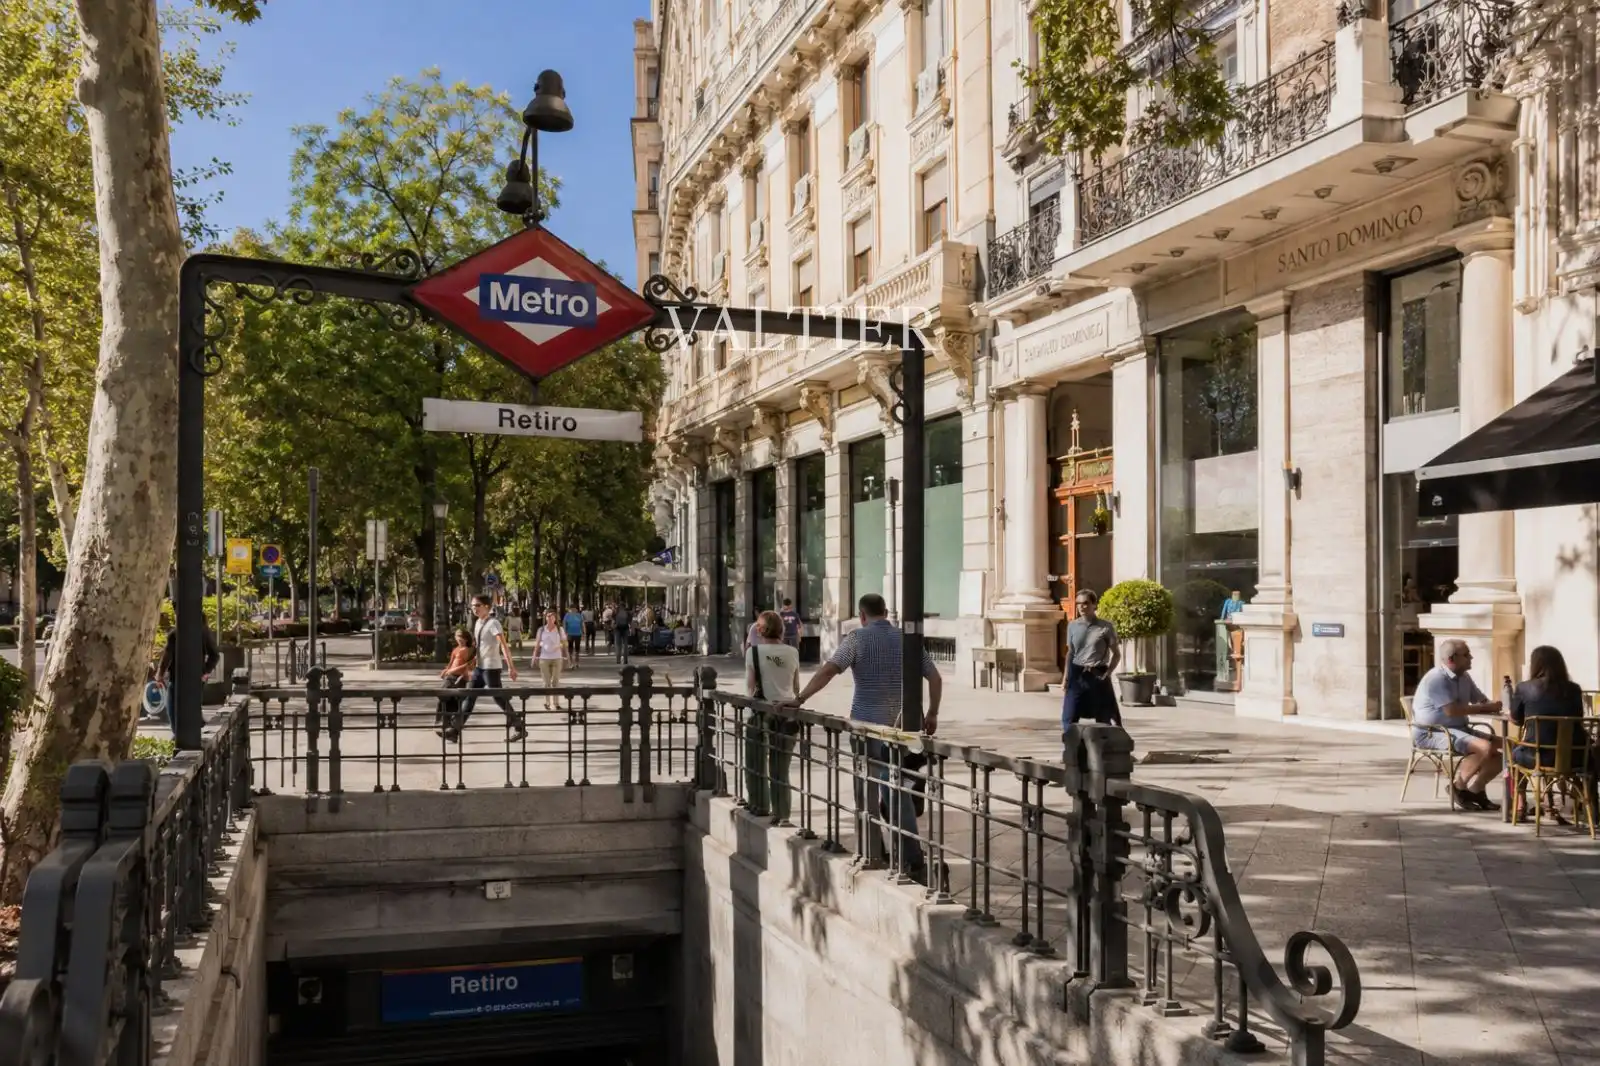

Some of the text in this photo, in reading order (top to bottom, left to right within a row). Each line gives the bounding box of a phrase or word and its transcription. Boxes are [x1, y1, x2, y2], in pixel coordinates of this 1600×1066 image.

[1277, 204, 1423, 273] SANTO DOMINGO
[490, 281, 589, 318] Metro
[498, 408, 577, 432] Retiro
[450, 974, 519, 995] Retiro
